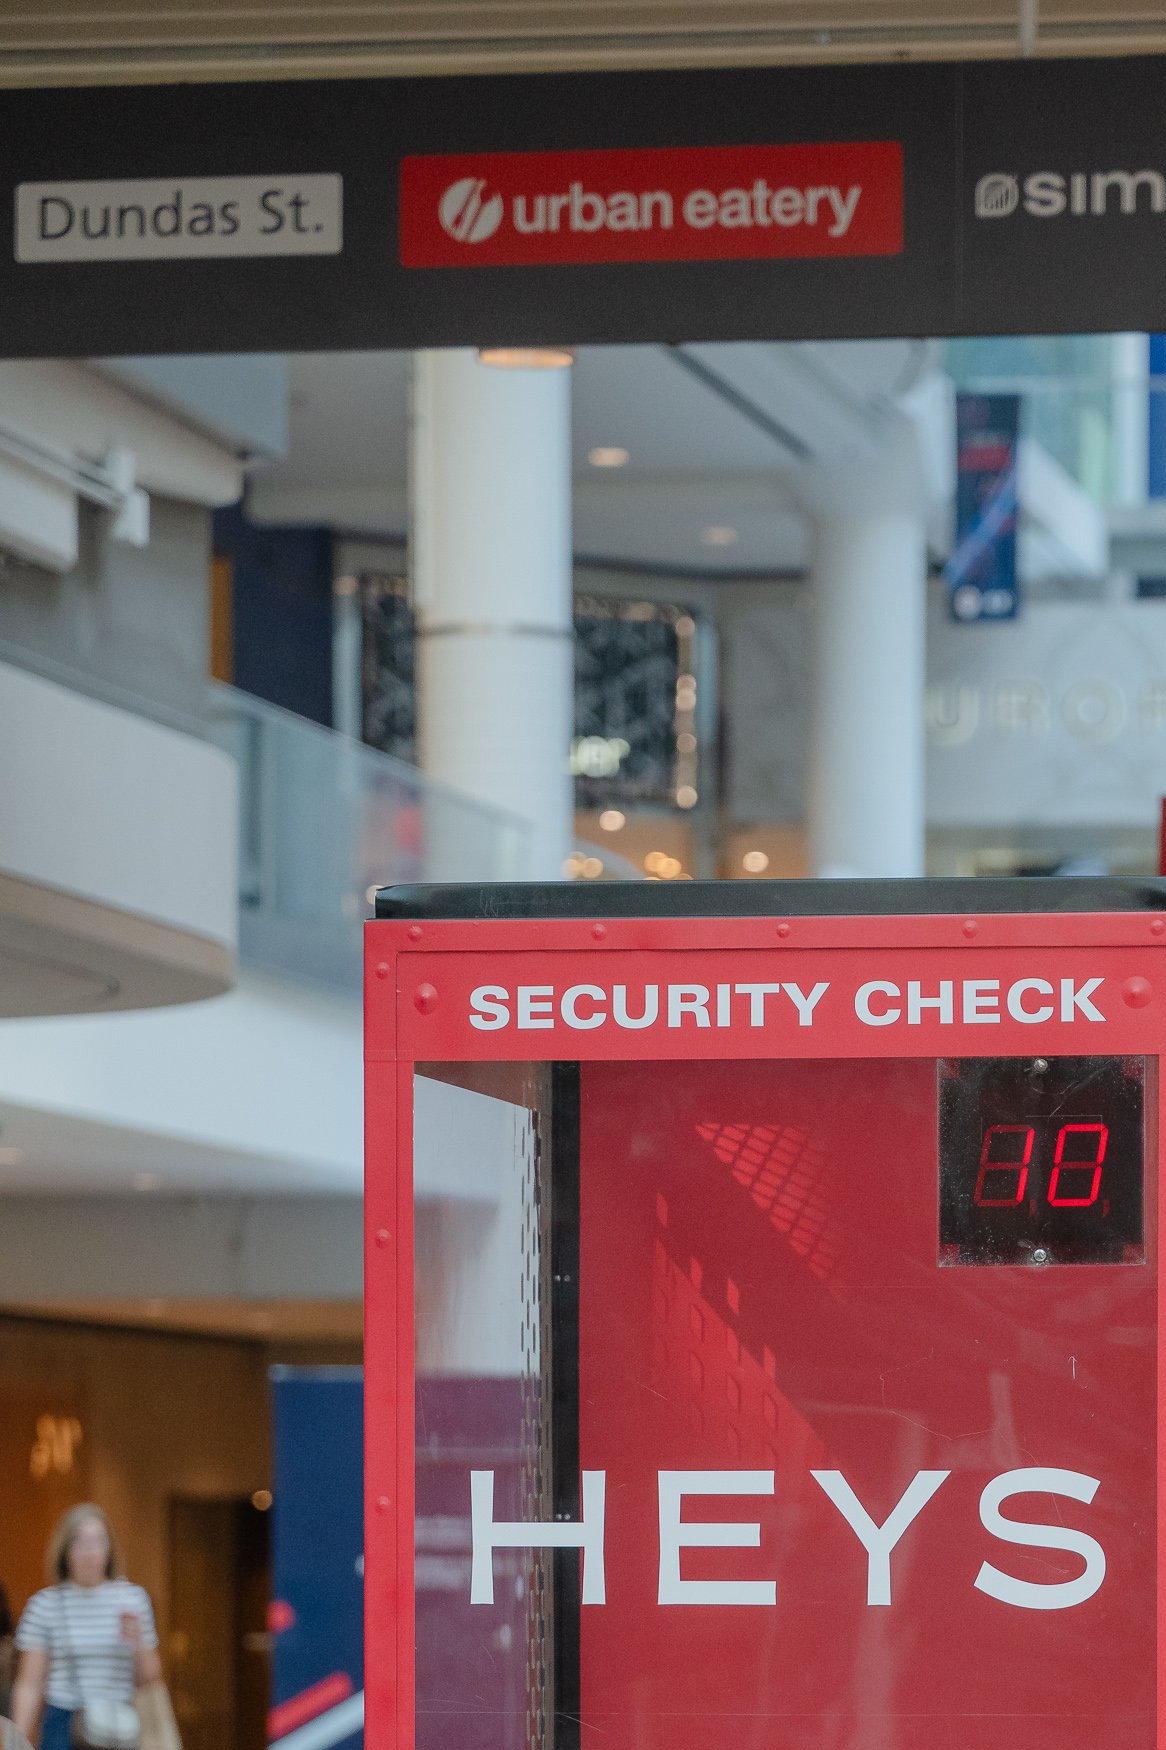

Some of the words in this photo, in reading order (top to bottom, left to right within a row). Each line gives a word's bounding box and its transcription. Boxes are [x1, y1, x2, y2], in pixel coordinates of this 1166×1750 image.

[37, 189, 240, 241] Dundas
[257, 187, 323, 236] St.
[511, 180, 675, 236] urban
[683, 178, 863, 239] eatery
[468, 982, 831, 1031] SECURITY
[853, 977, 1108, 1027] CHECK
[1015, 1123, 1109, 1207] 10
[470, 1466, 1107, 1610] HEYS
